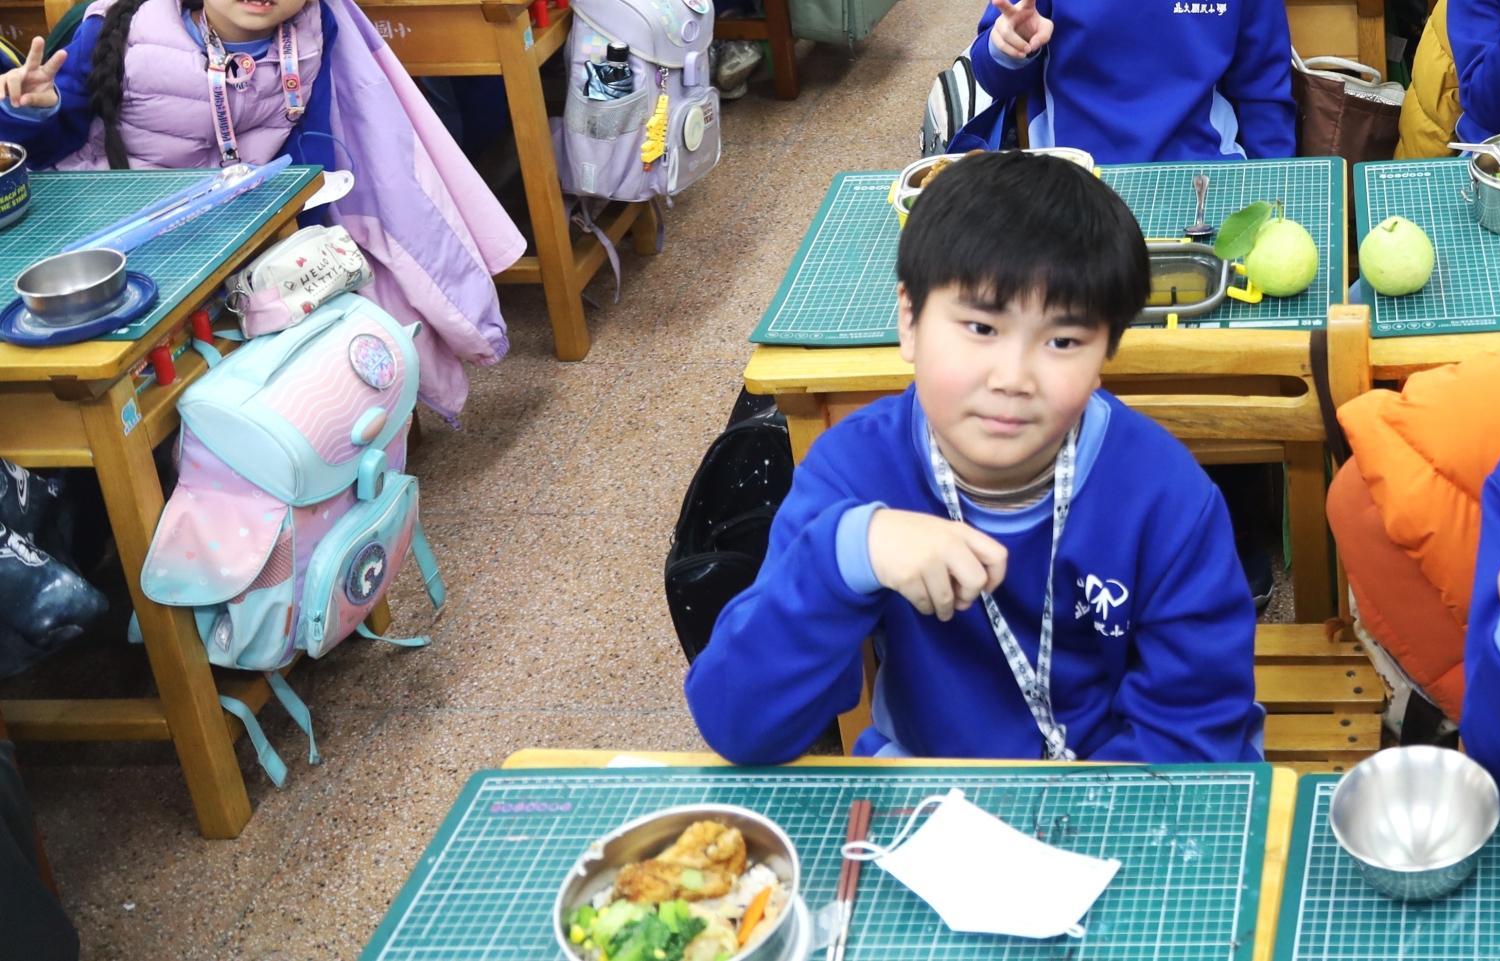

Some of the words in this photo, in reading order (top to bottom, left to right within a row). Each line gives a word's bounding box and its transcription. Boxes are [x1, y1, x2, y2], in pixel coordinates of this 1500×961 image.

[1173, 1, 1227, 16] 北大國民小學
[300, 258, 330, 286] HELLO
[304, 264, 340, 295] KITTY
[1017, 660, 1032, 685] MOUSE
